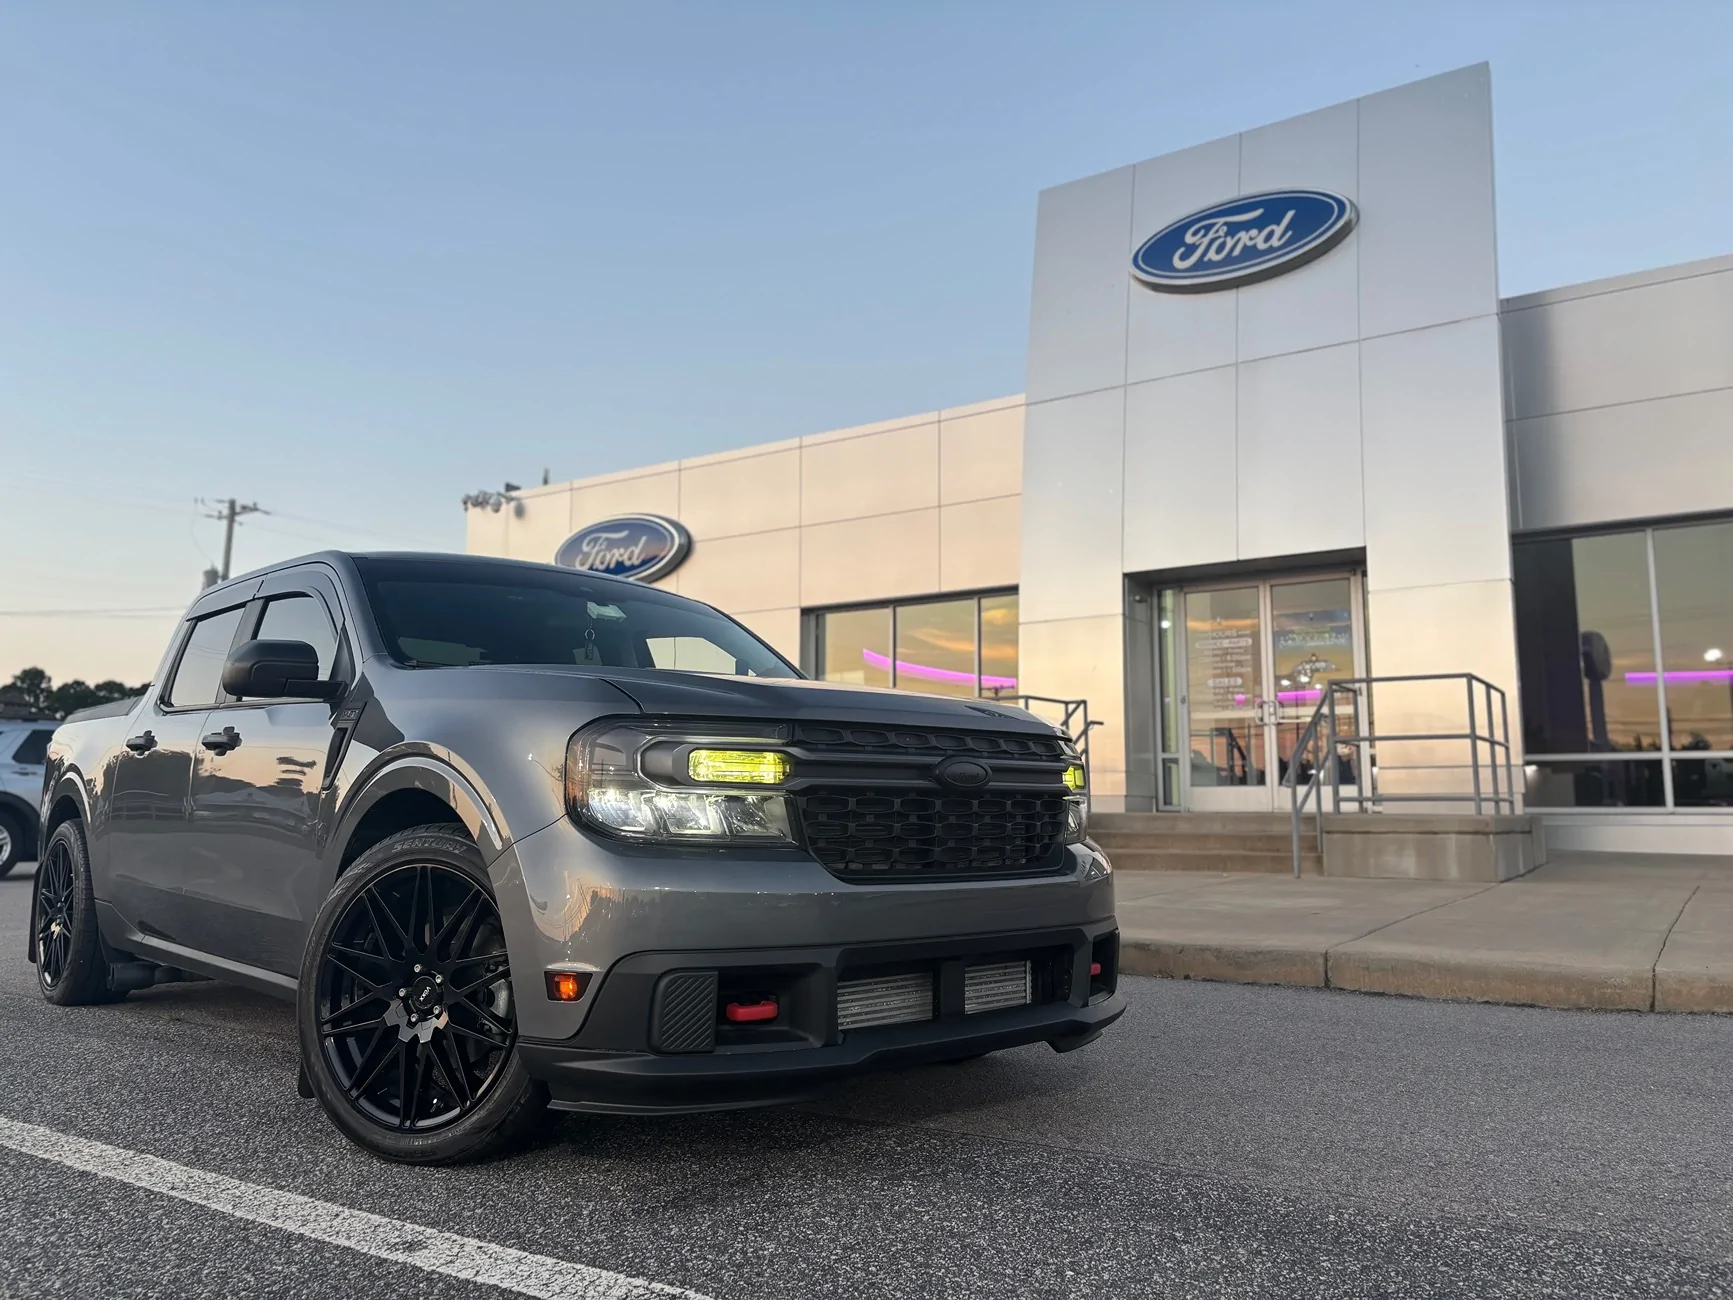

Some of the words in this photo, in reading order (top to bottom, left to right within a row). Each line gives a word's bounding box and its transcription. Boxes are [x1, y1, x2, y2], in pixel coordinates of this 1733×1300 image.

[1172, 208, 1296, 270] Ford
[575, 530, 648, 571] Ford
[391, 838, 468, 857] SENTURY
